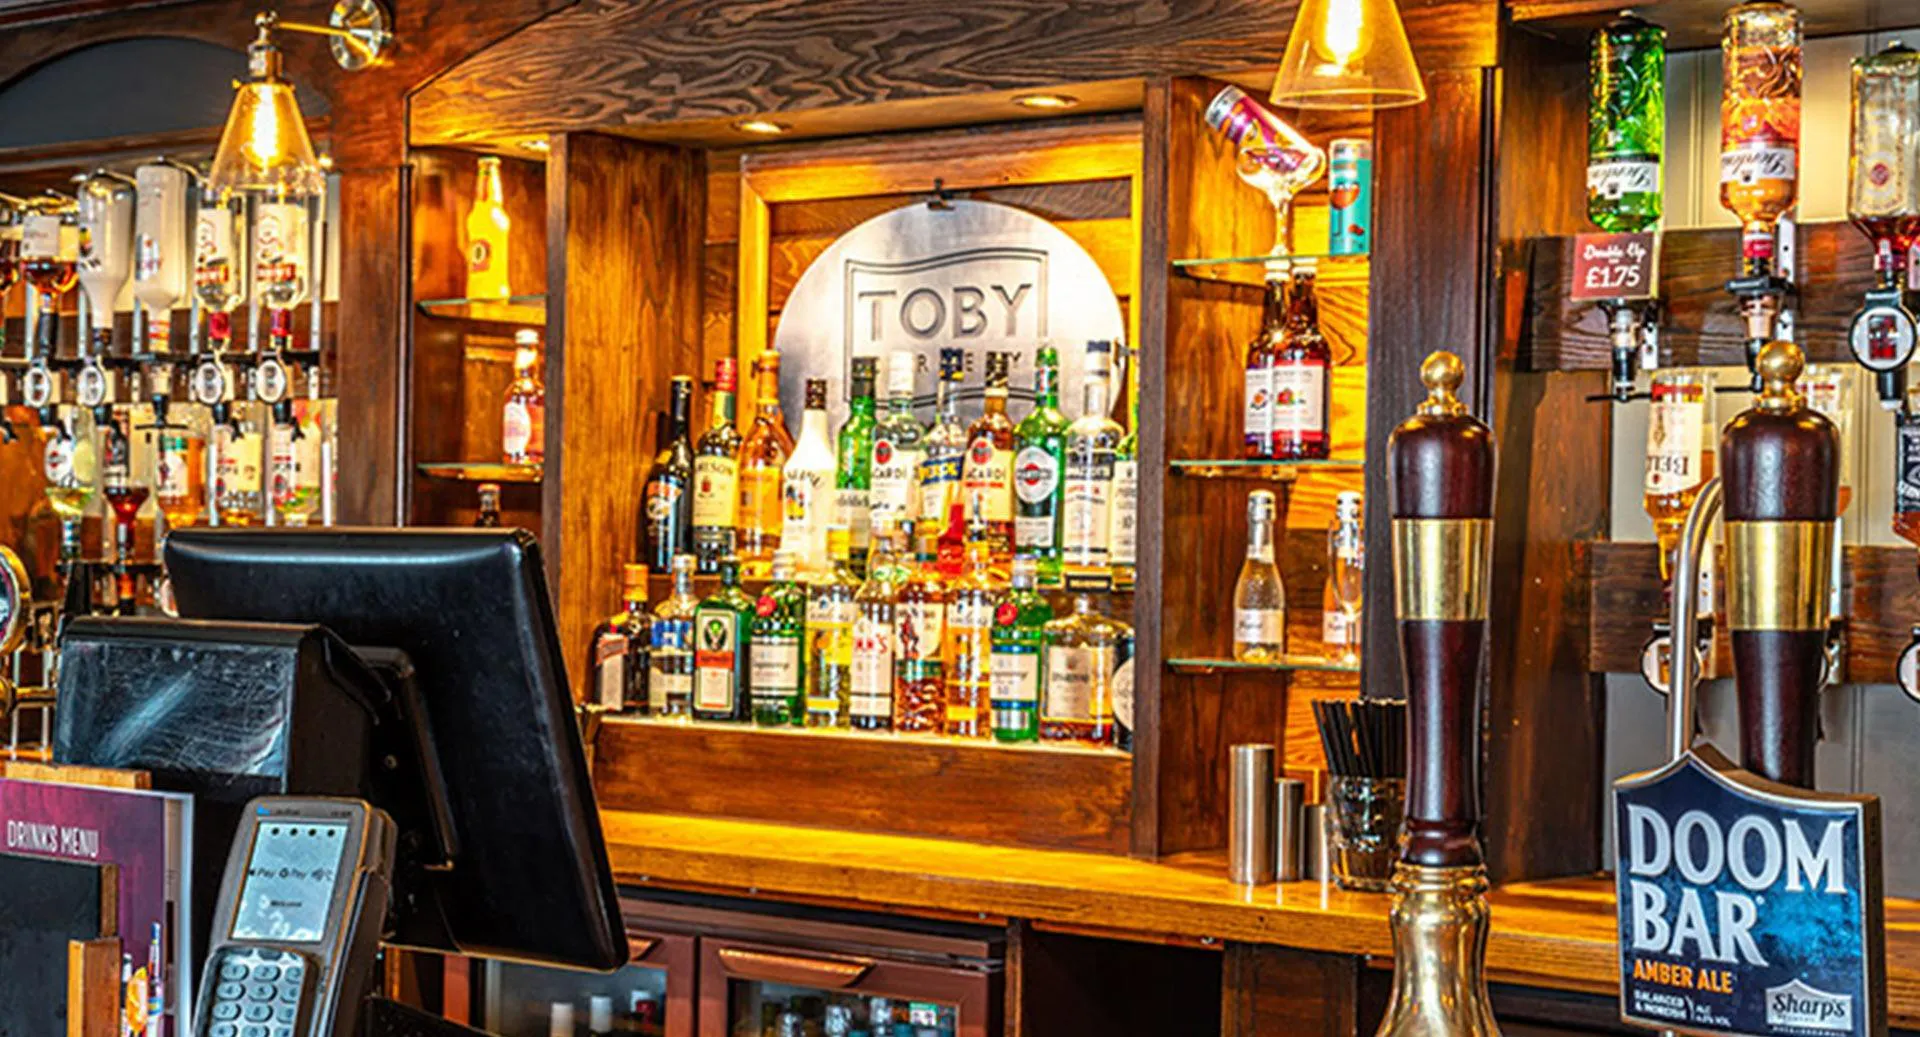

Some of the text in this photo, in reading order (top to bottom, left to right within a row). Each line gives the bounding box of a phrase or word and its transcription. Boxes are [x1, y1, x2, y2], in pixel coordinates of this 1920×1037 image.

[858, 283, 1032, 341] TOBY
[7, 819, 99, 856] DRINKS MENU
[1626, 804, 1849, 893] DOOM
[1630, 879, 1769, 967] BAR
[1633, 958, 1734, 994] AMBER ALE
[1772, 993, 1845, 1020] Sharp's
